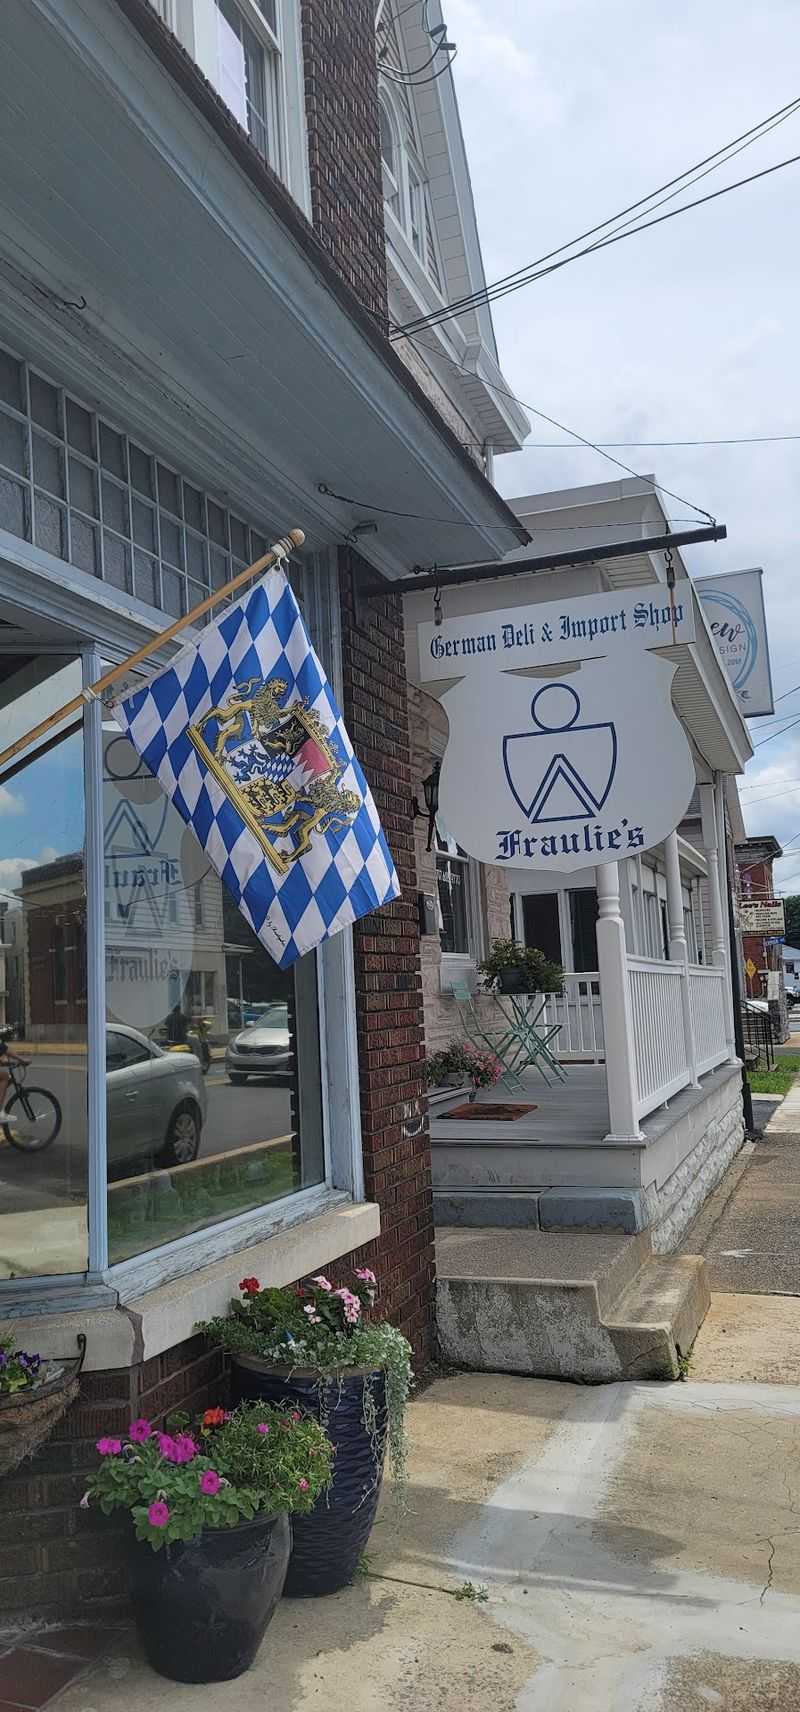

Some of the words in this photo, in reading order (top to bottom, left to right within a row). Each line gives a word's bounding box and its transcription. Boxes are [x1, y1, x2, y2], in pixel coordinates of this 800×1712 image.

[430, 634, 496, 659] German
[501, 623, 535, 648] Deli
[541, 622, 553, 642] &
[559, 609, 626, 640] Import
[633, 602, 684, 632] Shop
[495, 818, 645, 860] Fraulie's
